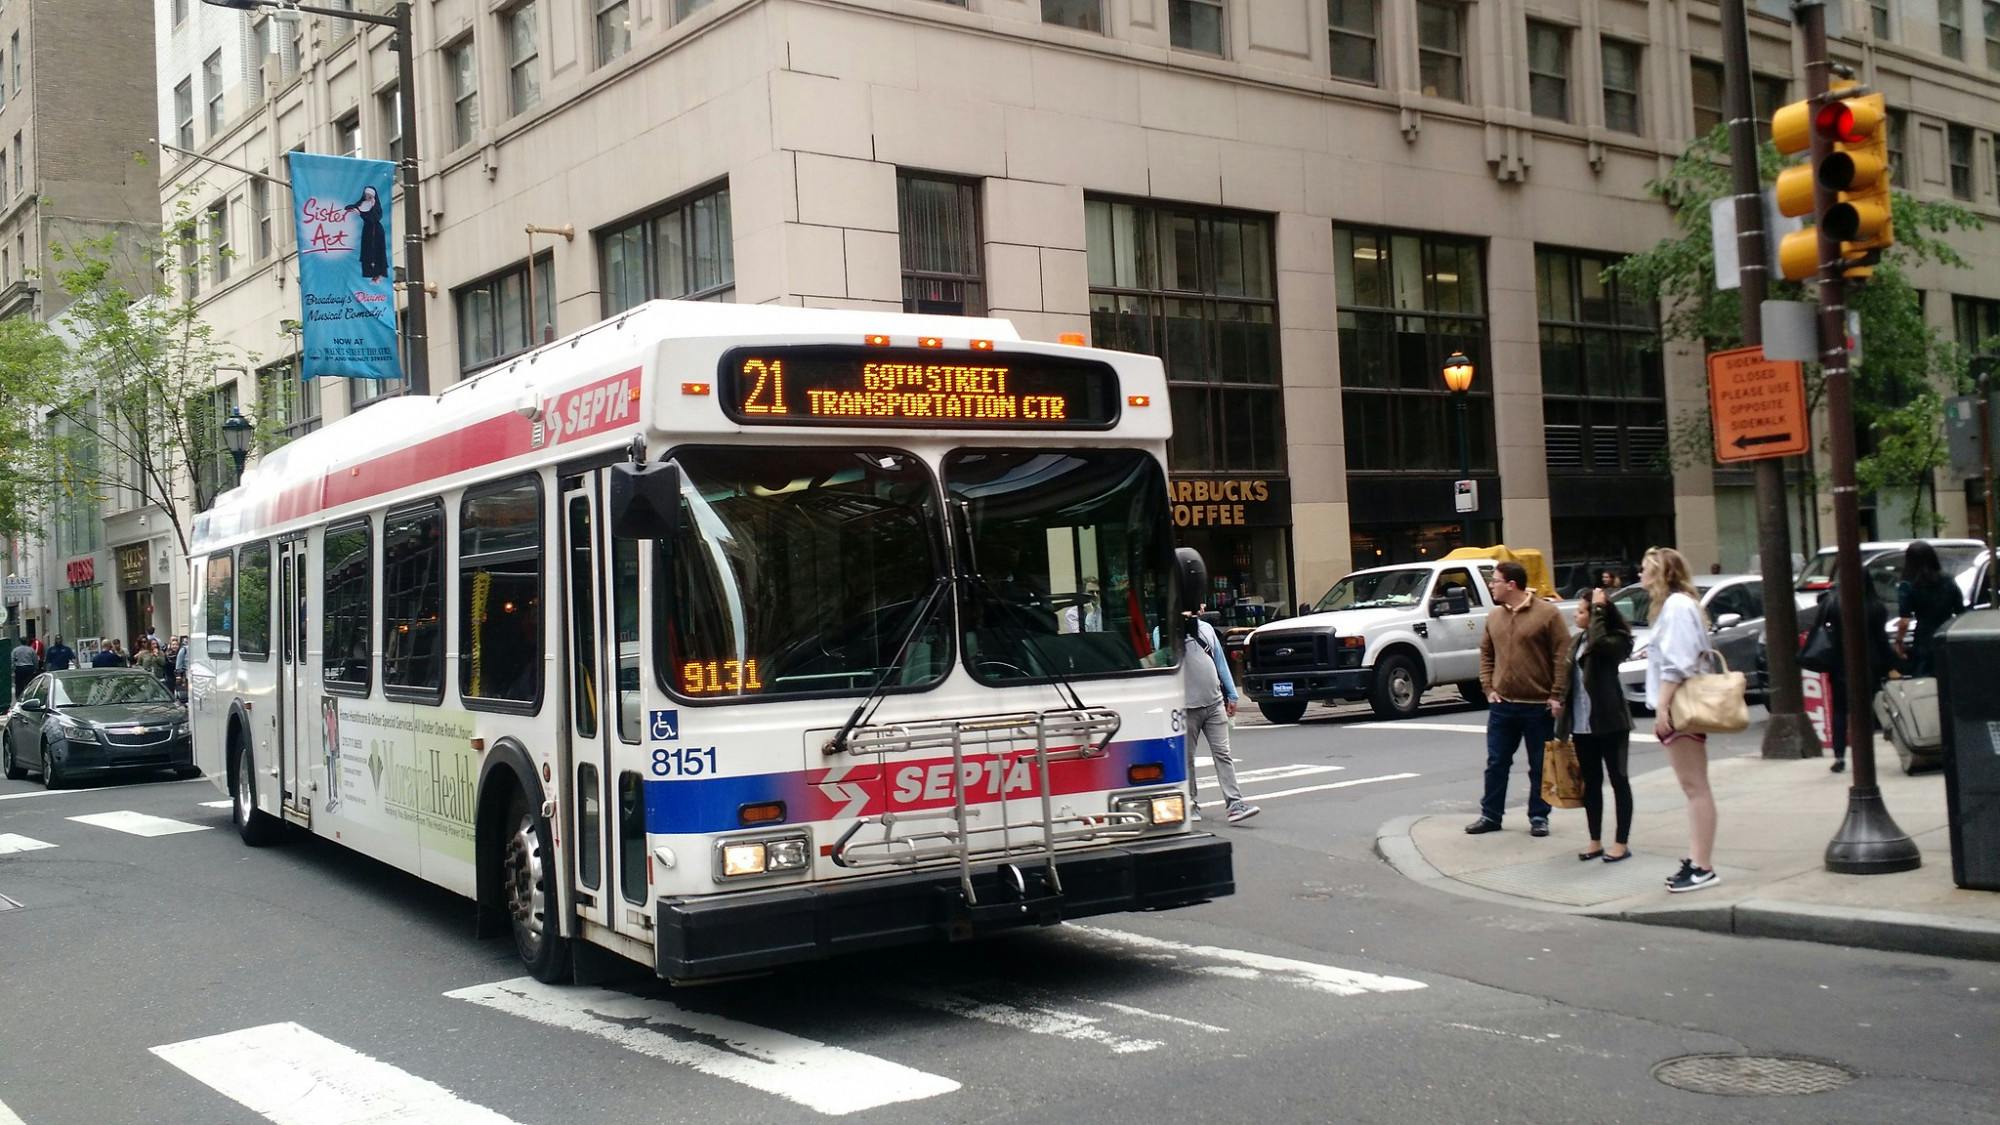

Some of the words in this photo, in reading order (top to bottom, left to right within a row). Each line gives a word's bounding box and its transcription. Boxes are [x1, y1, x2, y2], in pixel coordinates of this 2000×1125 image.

[303, 197, 353, 224] Sister
[310, 223, 350, 253] Act
[305, 293, 353, 306] Broadway's
[307, 308, 343, 321] Musical
[344, 306, 387, 320] Comedy!
[743, 359, 787, 414] 21
[864, 363, 923, 390] 69TH
[926, 366, 1009, 393] STREET
[1732, 368, 1776, 384] CLOSED
[807, 390, 1016, 418] TRANSPORTATION
[1023, 396, 1065, 419] CTR
[1721, 385, 1763, 400] PLEASE
[1767, 382, 1791, 394] USE
[565, 378, 629, 435] SEPTA
[1730, 398, 1784, 415] OPPOSITE
[1730, 415, 1786, 430] SIDEWALK
[1171, 504, 1245, 527] OFFEE
[683, 659, 761, 692] 9131
[651, 746, 717, 776] 8151
[893, 759, 1032, 804] SEPTA
